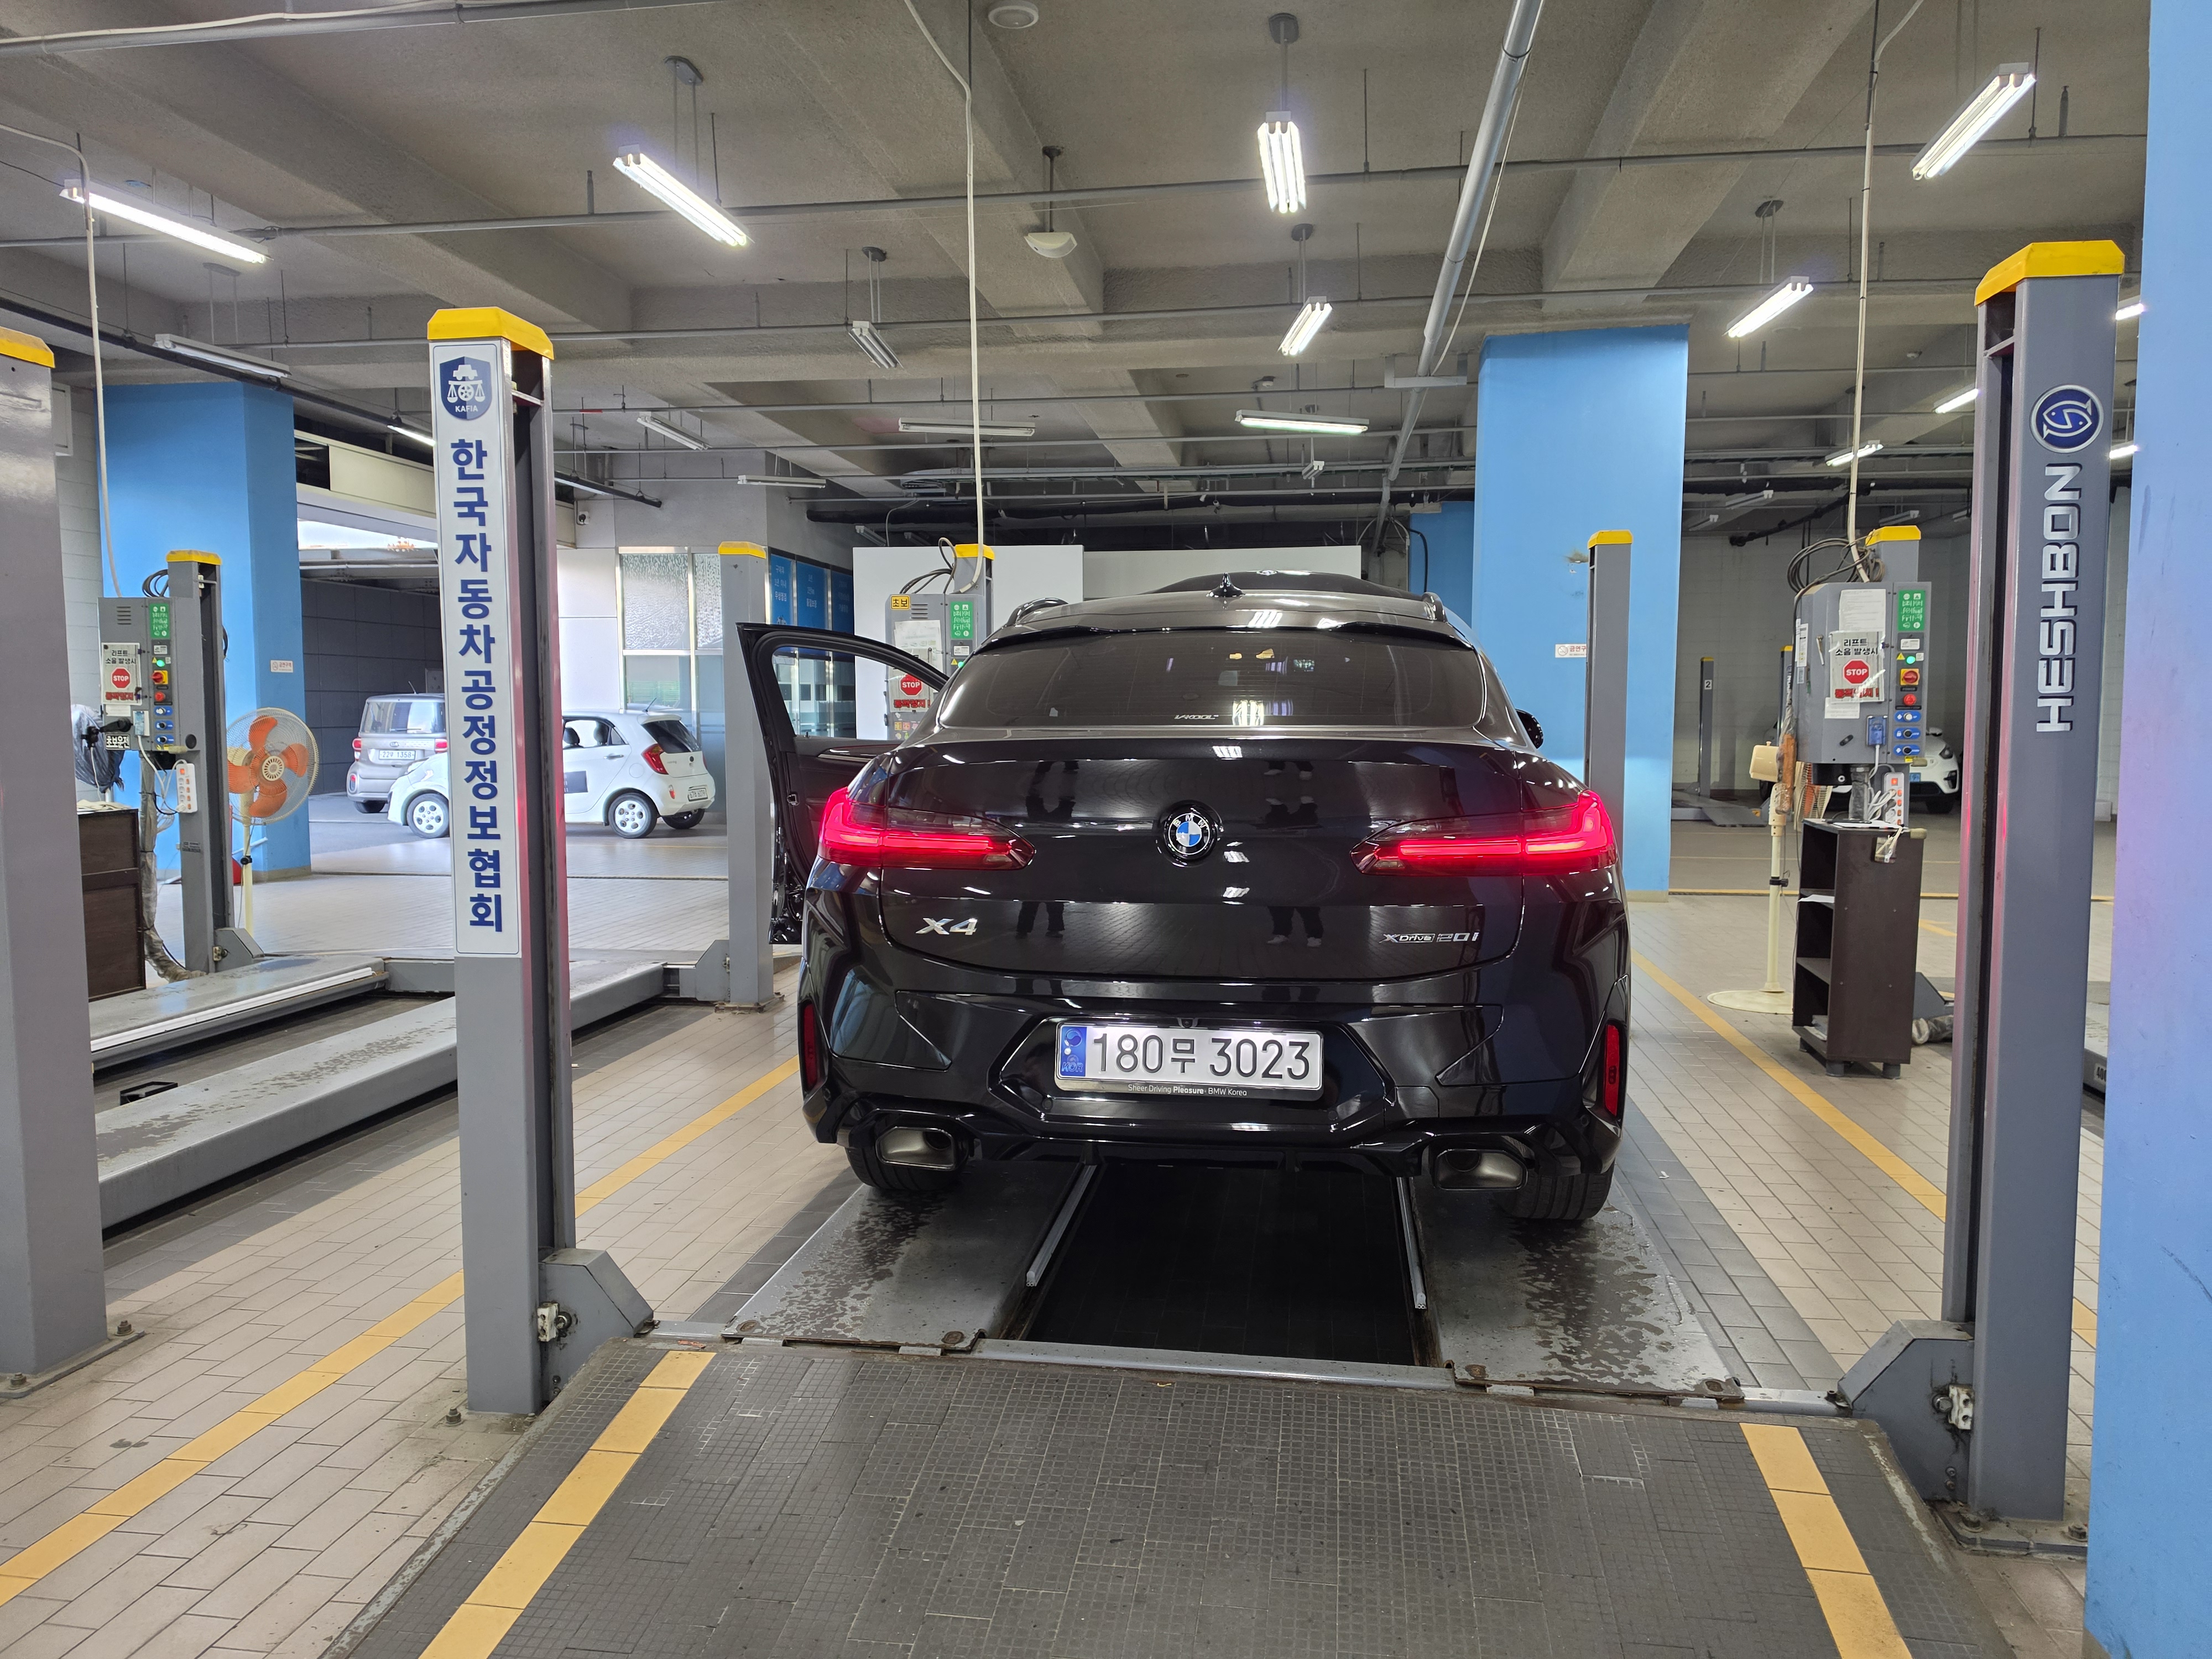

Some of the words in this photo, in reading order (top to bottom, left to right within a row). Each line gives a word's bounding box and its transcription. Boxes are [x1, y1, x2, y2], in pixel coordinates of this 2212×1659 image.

[892, 598, 908, 607] 초보
[2036, 463, 2082, 732] HESHBON
[451, 439, 503, 932] 한국자동차공정정보협회
[893, 699, 926, 708] 동작정지
[106, 735, 130, 749] 초보운전
[1172, 815, 1207, 828] BMW
[915, 918, 978, 935] X4
[1093, 1033, 1196, 1073] 180무
[1209, 1037, 1310, 1080] 3023
[1061, 1061, 1083, 1073] KOR
[1128, 1084, 1147, 1092] Sheer
[1149, 1085, 1171, 1093] Driving
[1173, 1086, 1204, 1094] Pleasure
